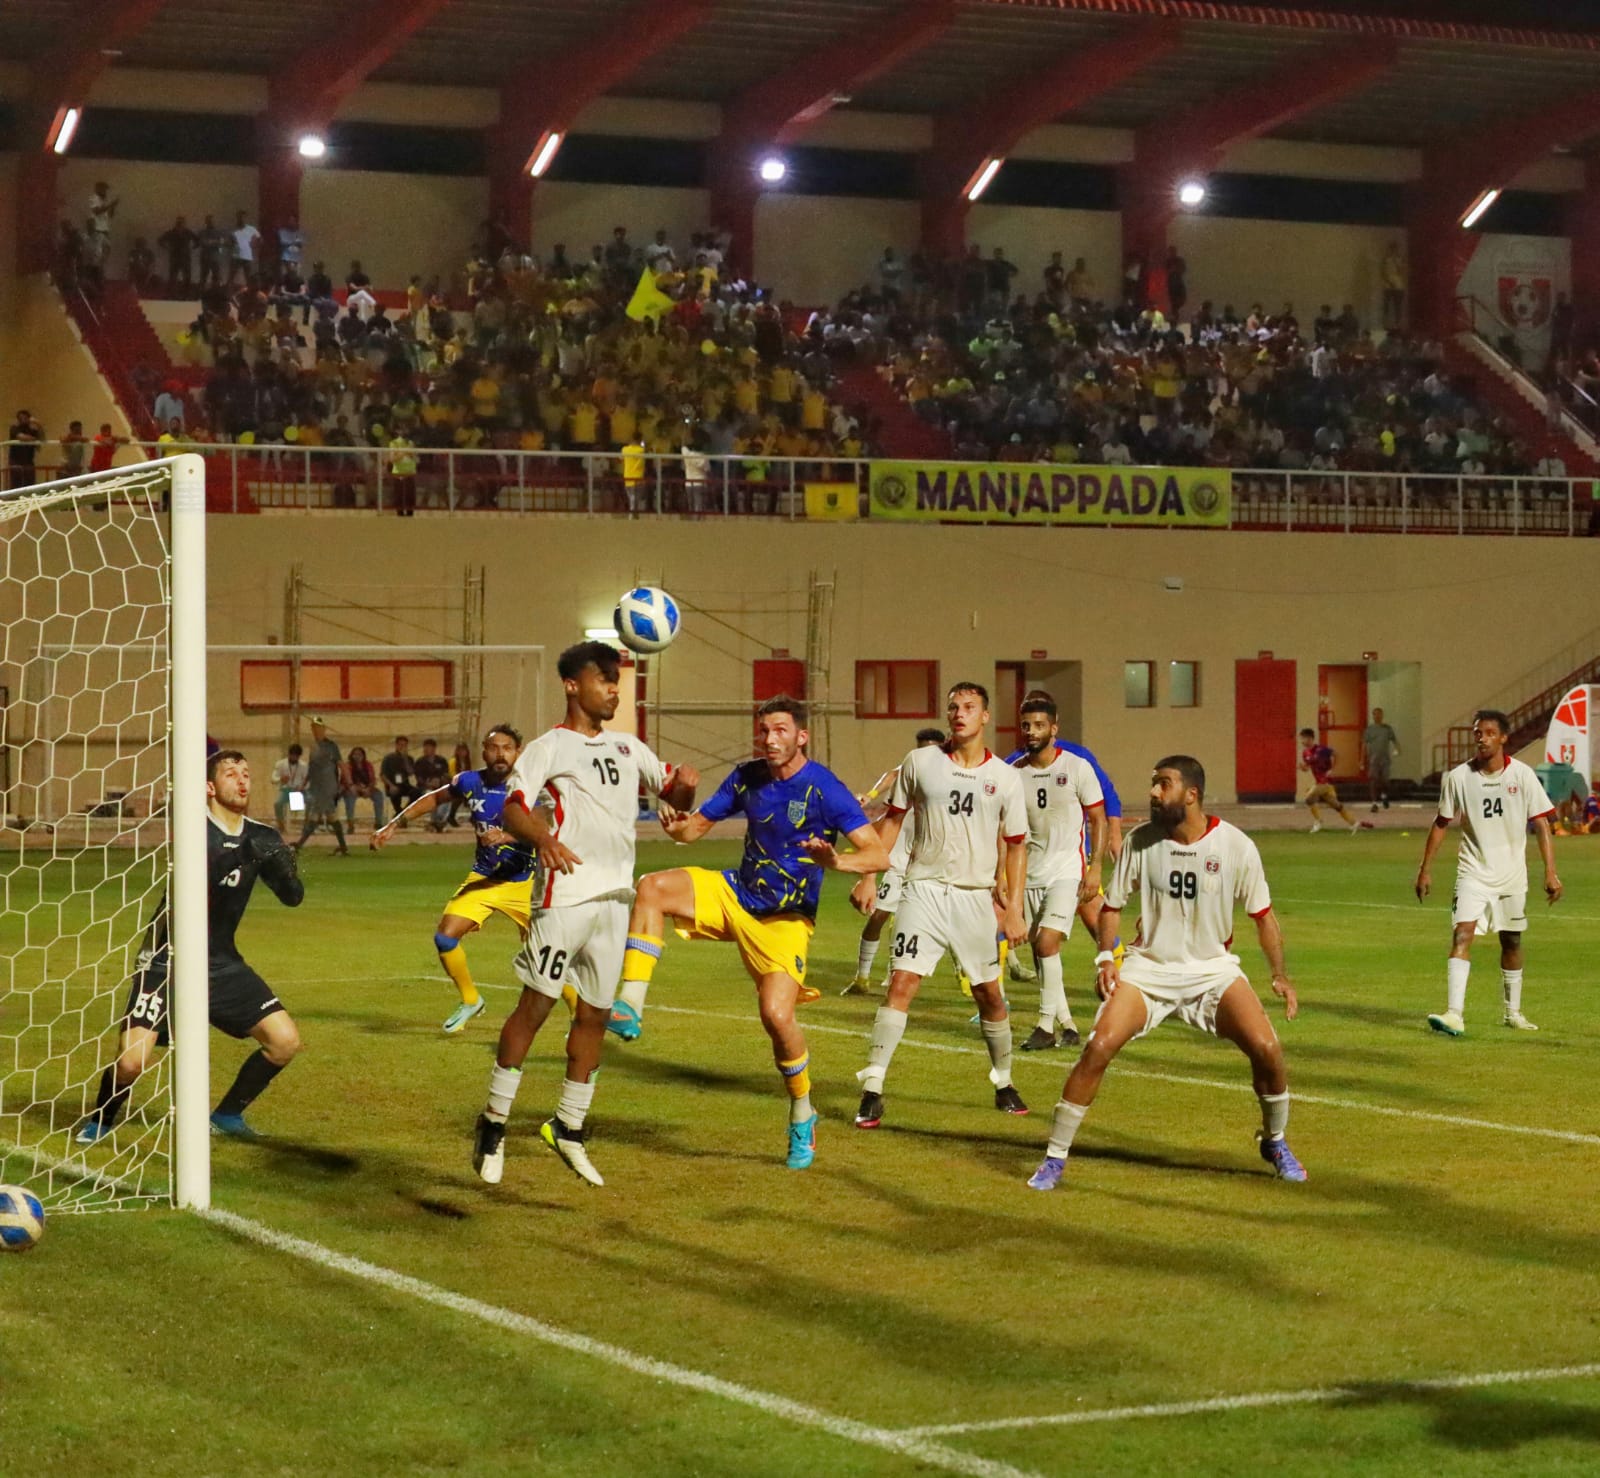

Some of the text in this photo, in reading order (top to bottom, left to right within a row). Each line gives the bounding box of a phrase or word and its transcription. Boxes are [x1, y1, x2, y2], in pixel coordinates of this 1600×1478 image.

[916, 471, 1185, 518] MANJAPPADA
[592, 757, 620, 786] 16
[948, 789, 974, 817] 34
[1037, 787, 1047, 809] 8
[1482, 797, 1504, 819] 24
[1168, 870, 1197, 900] 99
[894, 931, 919, 959] 34
[538, 944, 567, 980] 16
[132, 991, 164, 1022] 55
